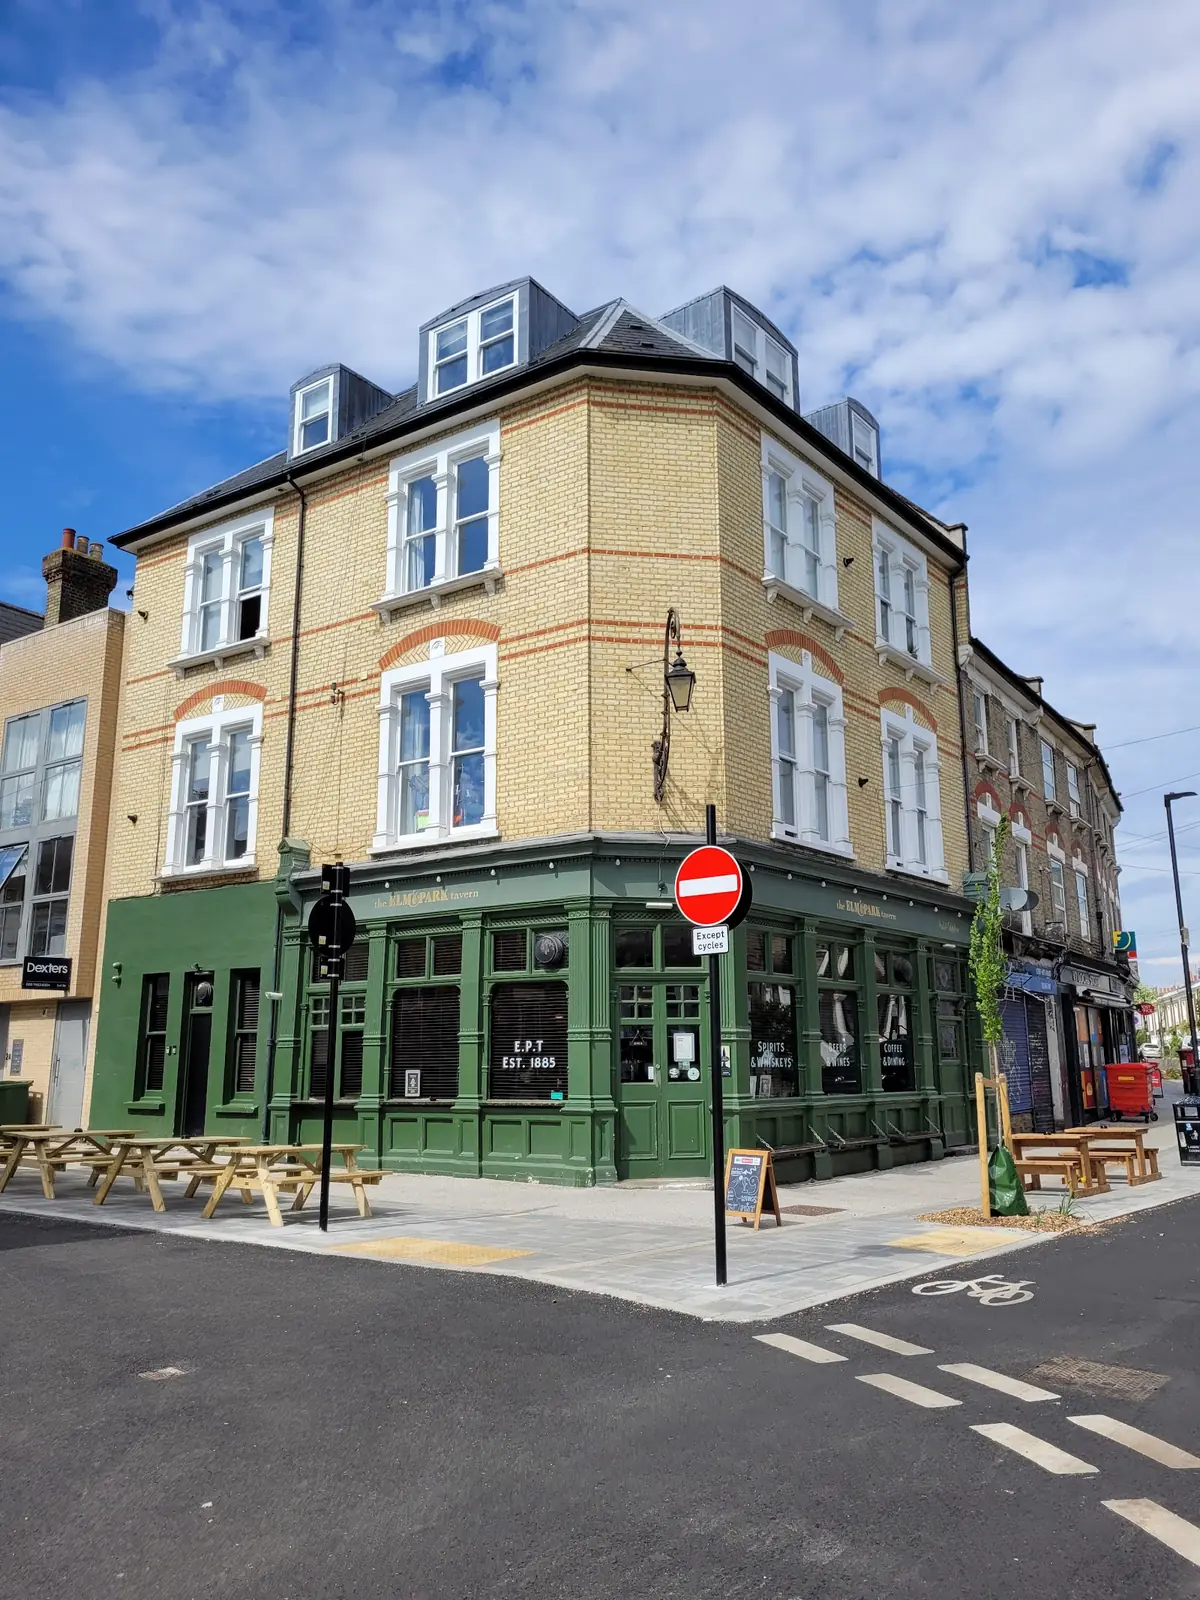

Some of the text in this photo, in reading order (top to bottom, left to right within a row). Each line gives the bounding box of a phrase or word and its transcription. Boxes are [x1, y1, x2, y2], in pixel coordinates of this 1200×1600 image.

[374, 898, 387, 909] the
[450, 890, 479, 900] tavern
[696, 930, 725, 940] Except
[698, 941, 724, 951] cycles
[27, 962, 68, 974] Dexters
[514, 1040, 544, 1052] E.P.T
[757, 1041, 785, 1052] SPIRITS
[883, 1043, 903, 1053] COFFEE
[502, 1057, 556, 1069] EST. 1885
